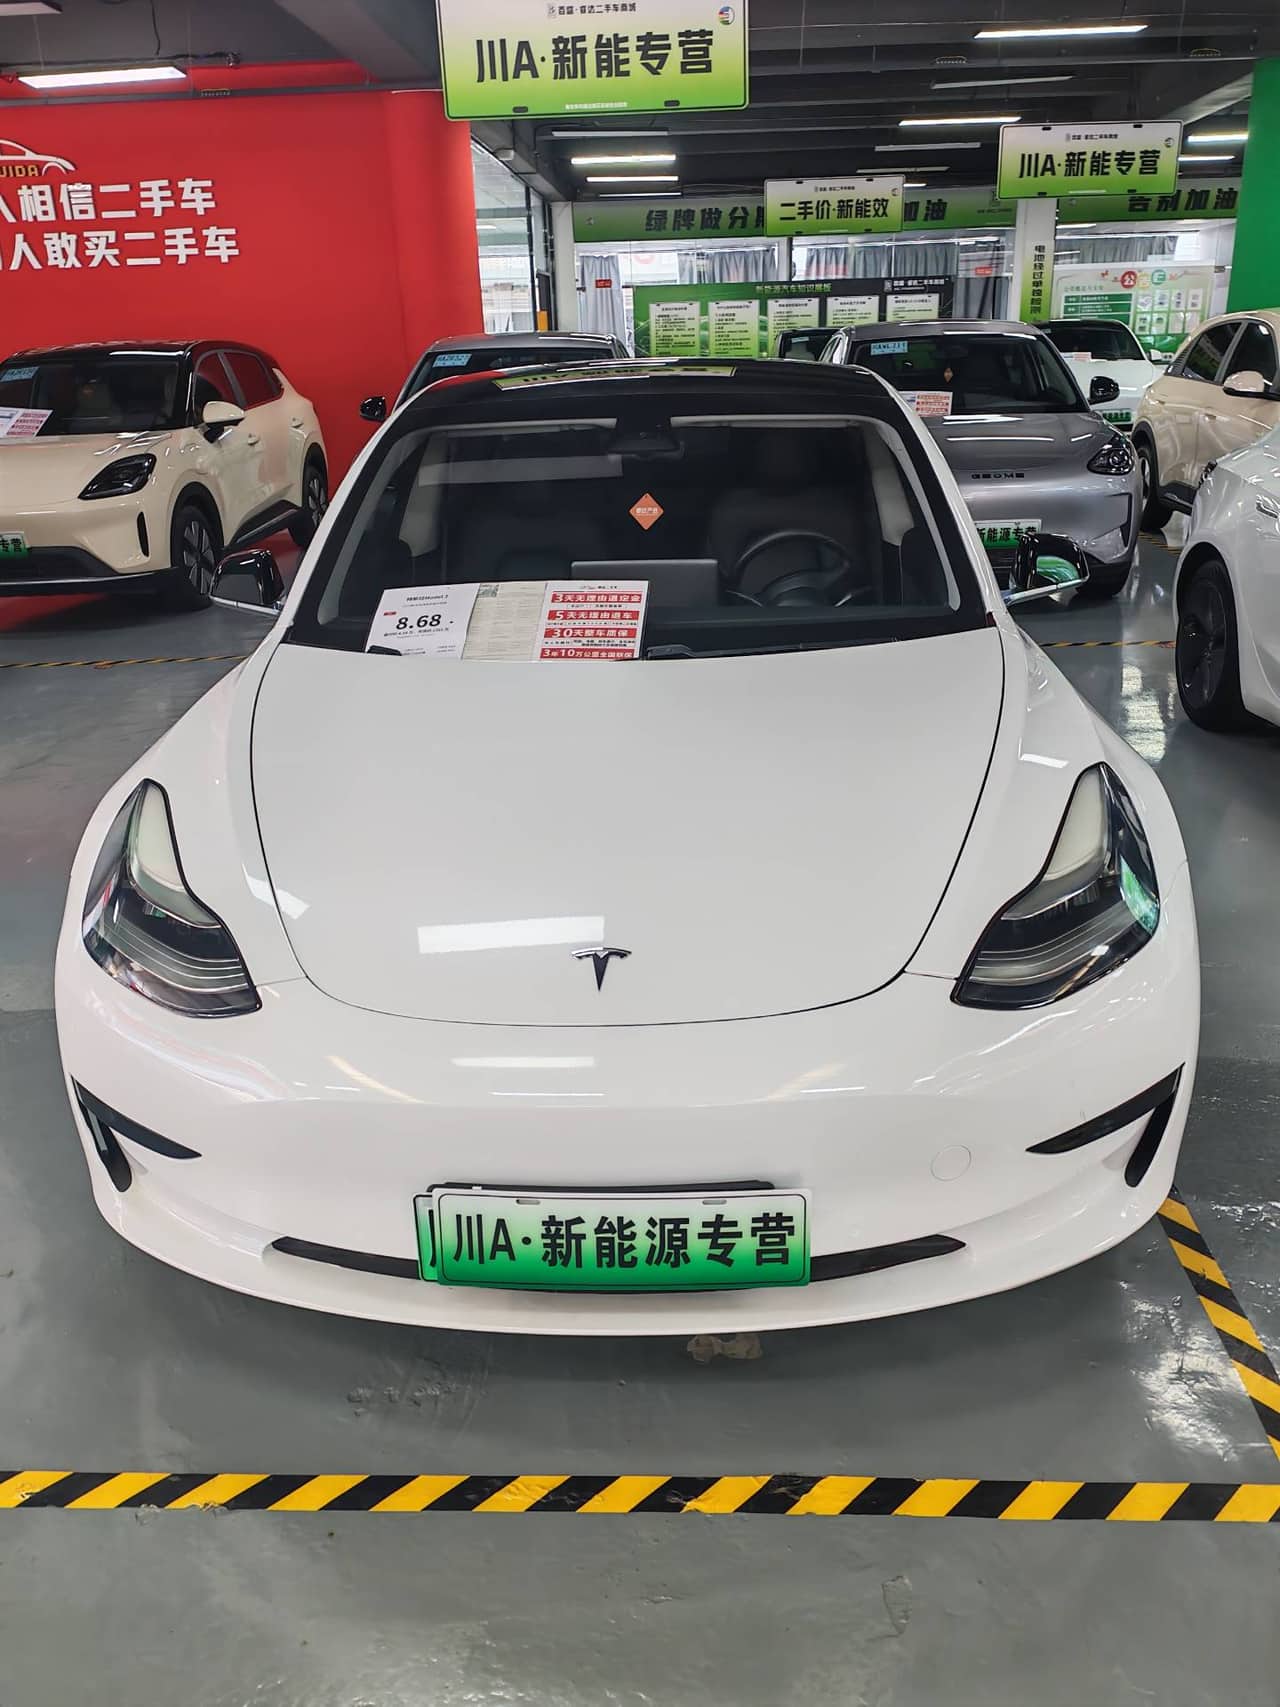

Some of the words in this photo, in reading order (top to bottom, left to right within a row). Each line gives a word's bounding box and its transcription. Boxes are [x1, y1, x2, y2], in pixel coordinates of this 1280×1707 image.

[476, 29, 714, 83] 川A·新能专营
[1018, 149, 1161, 179] 川A·新能专营
[780, 198, 889, 221] 二手价·新能效
[0, 226, 240, 271] 人敢买二手车
[395, 614, 442, 630] 8.68
[453, 1212, 796, 1269] 川A·新能源专营
